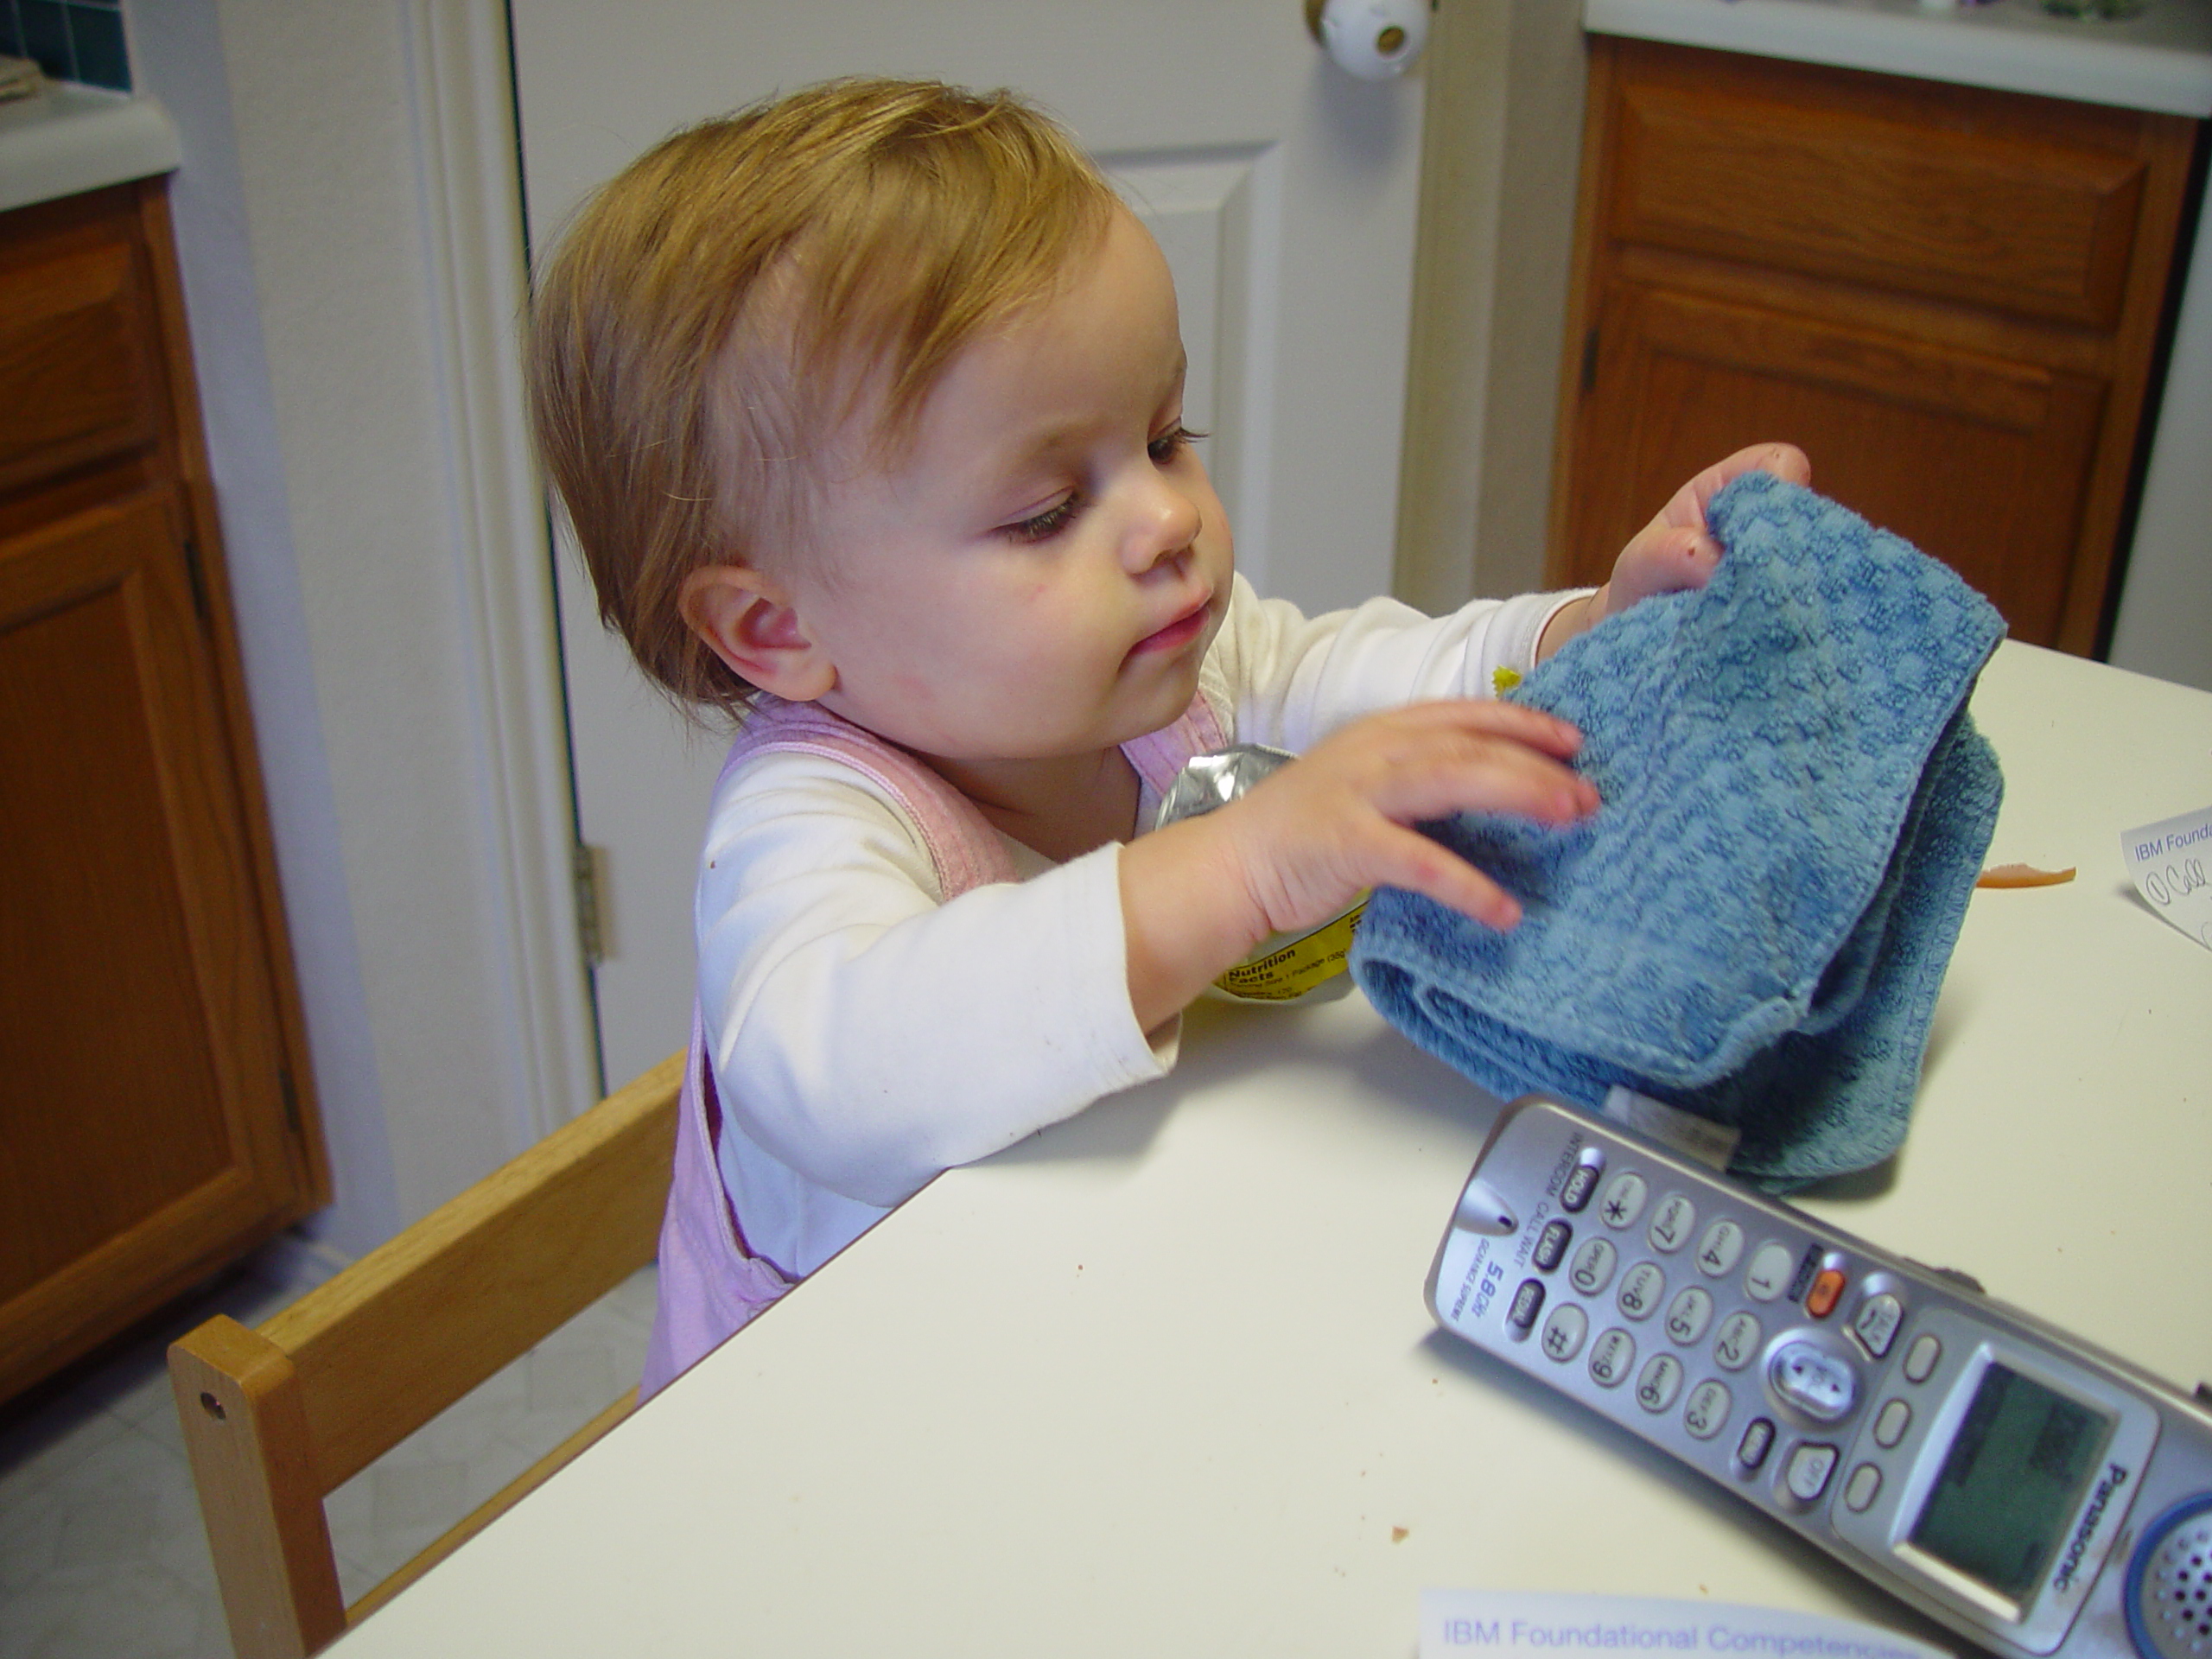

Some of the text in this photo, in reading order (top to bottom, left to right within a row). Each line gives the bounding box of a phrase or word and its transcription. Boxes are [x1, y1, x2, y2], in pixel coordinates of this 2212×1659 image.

[2135, 839, 2164, 862] IBM
[1229, 949, 1296, 979] Nutrition
[1545, 1131, 1583, 1198] INTERCOM
[1563, 1167, 1590, 1205] HOLD
[1511, 1201, 1549, 1268] CALL WAIT
[1535, 1225, 1560, 1264] FLASH
[1650, 1224, 1675, 1244] 7
[1700, 1246, 1724, 1267] 4
[1572, 1267, 1597, 1287] 0
[1749, 1273, 1773, 1290] 1
[1619, 1290, 1644, 1312] 8
[1667, 1315, 1692, 1337] 5
[1714, 1339, 1741, 1363] 2
[1589, 1358, 1614, 1380] 9
[1637, 1384, 1662, 1405] 6
[1683, 1409, 1709, 1431] 3
[2053, 1462, 2127, 1592] Panasonic
[1444, 1619, 1500, 1645] IBM
[1512, 1620, 1697, 1650] Foundational
